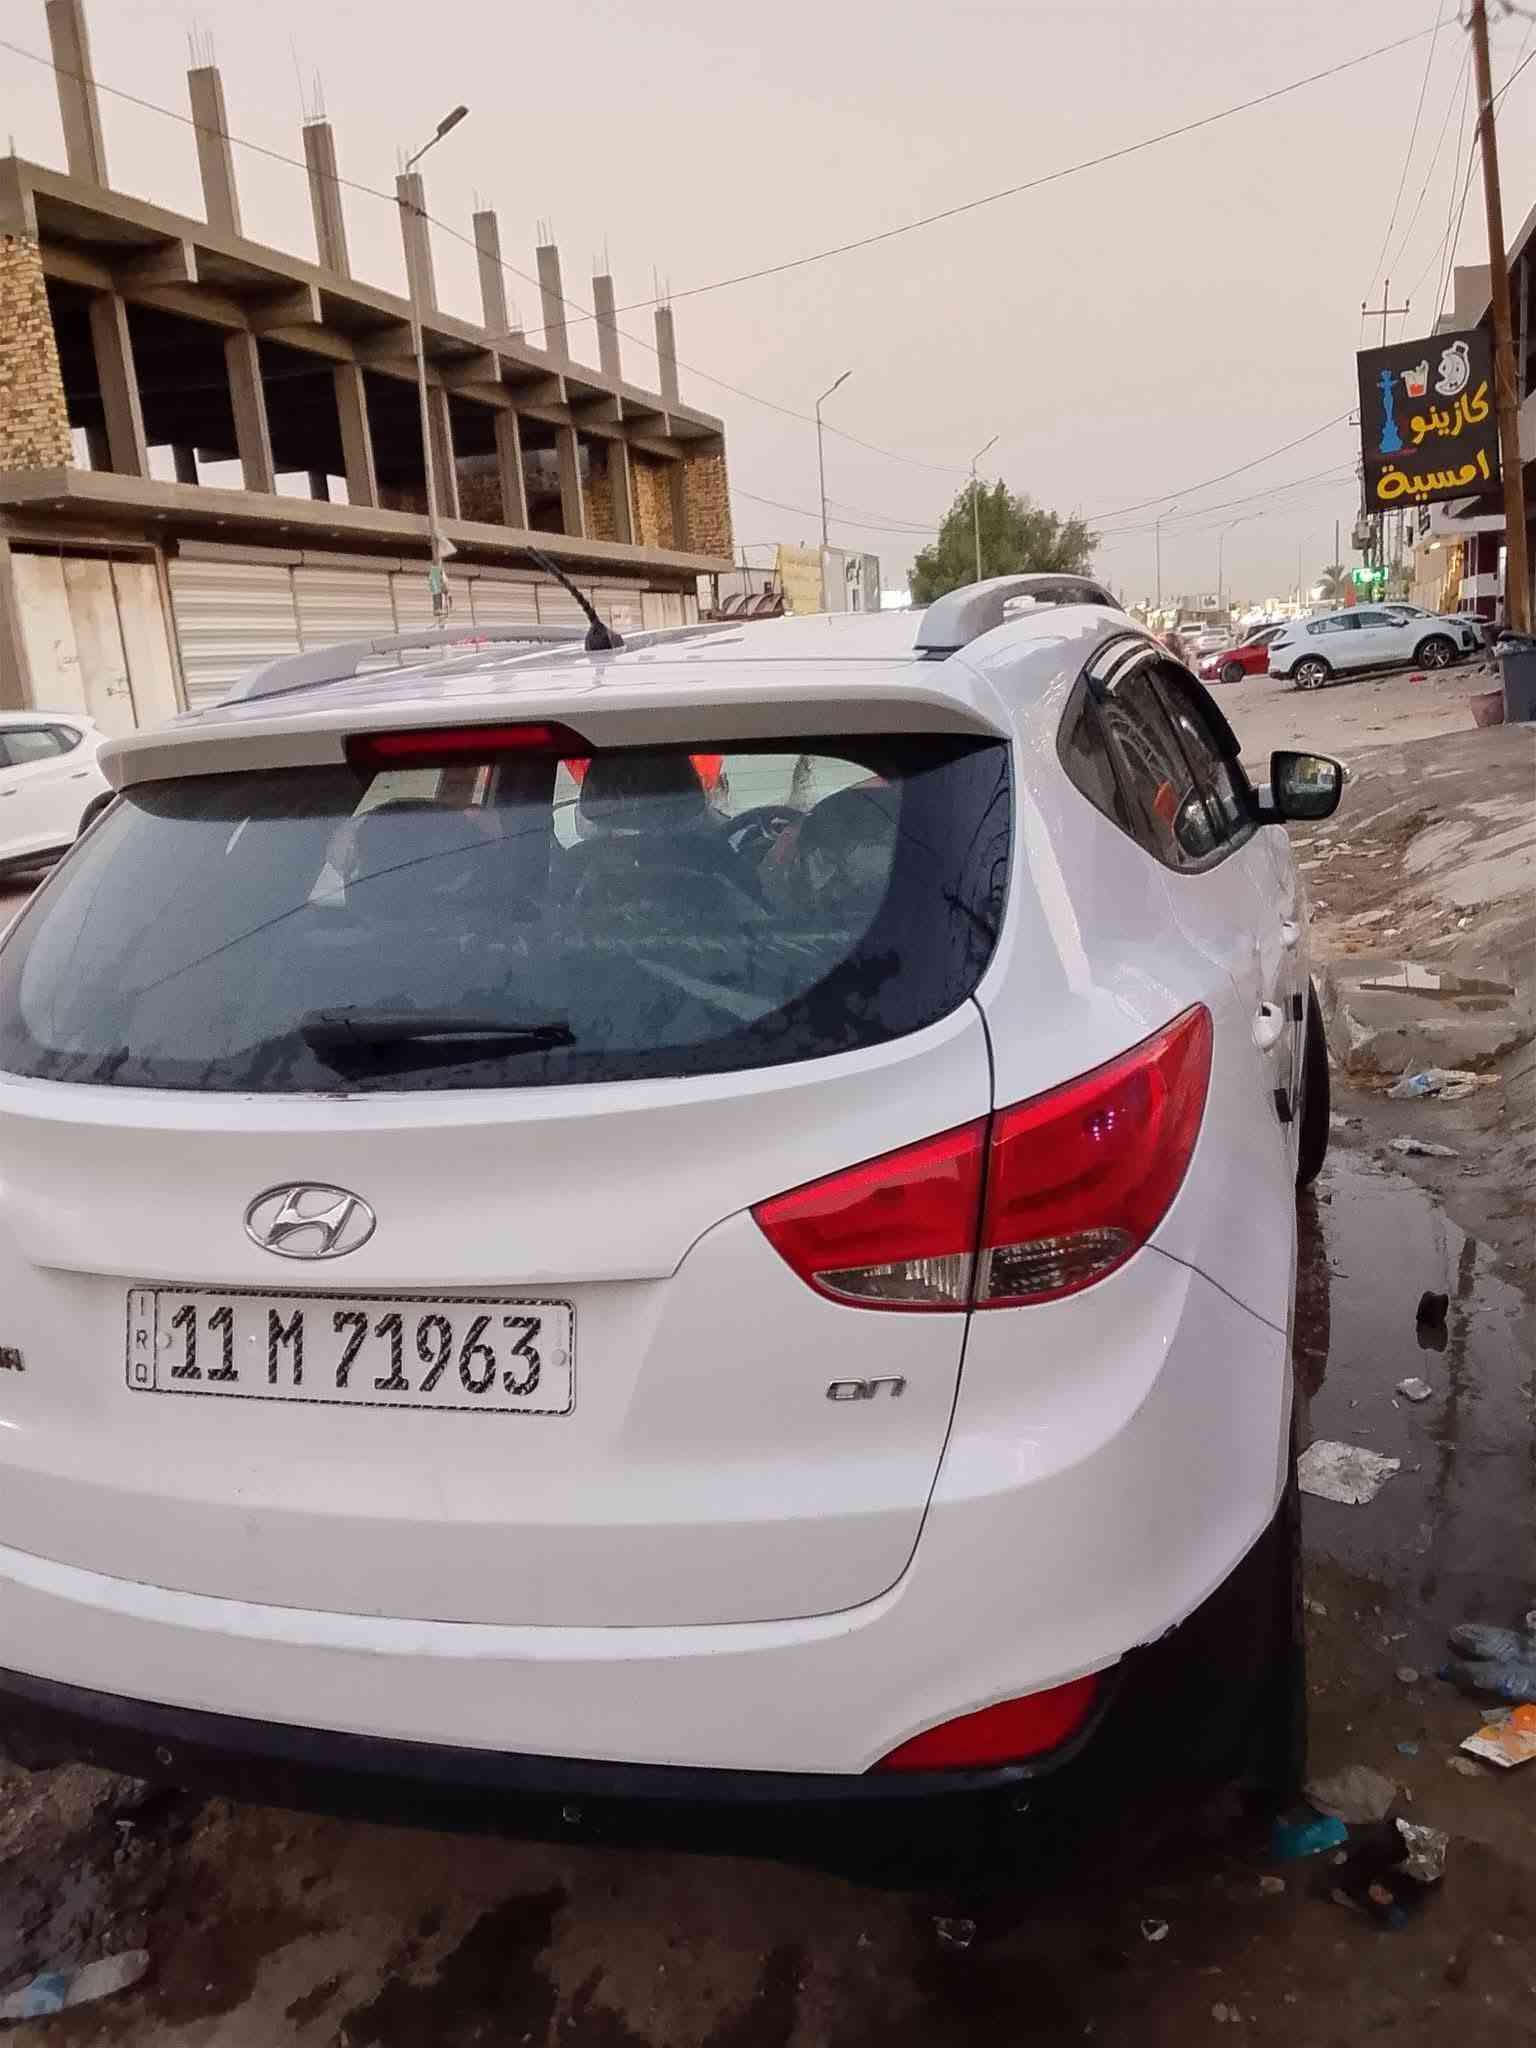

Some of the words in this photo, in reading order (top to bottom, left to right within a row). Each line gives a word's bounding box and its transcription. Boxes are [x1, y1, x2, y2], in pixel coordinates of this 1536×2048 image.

[1411, 380, 1489, 444] كازينو
[1377, 448, 1490, 500] امسية
[171, 1304, 239, 1381] 11
[267, 1307, 304, 1385] M
[333, 1311, 542, 1396] 71963
